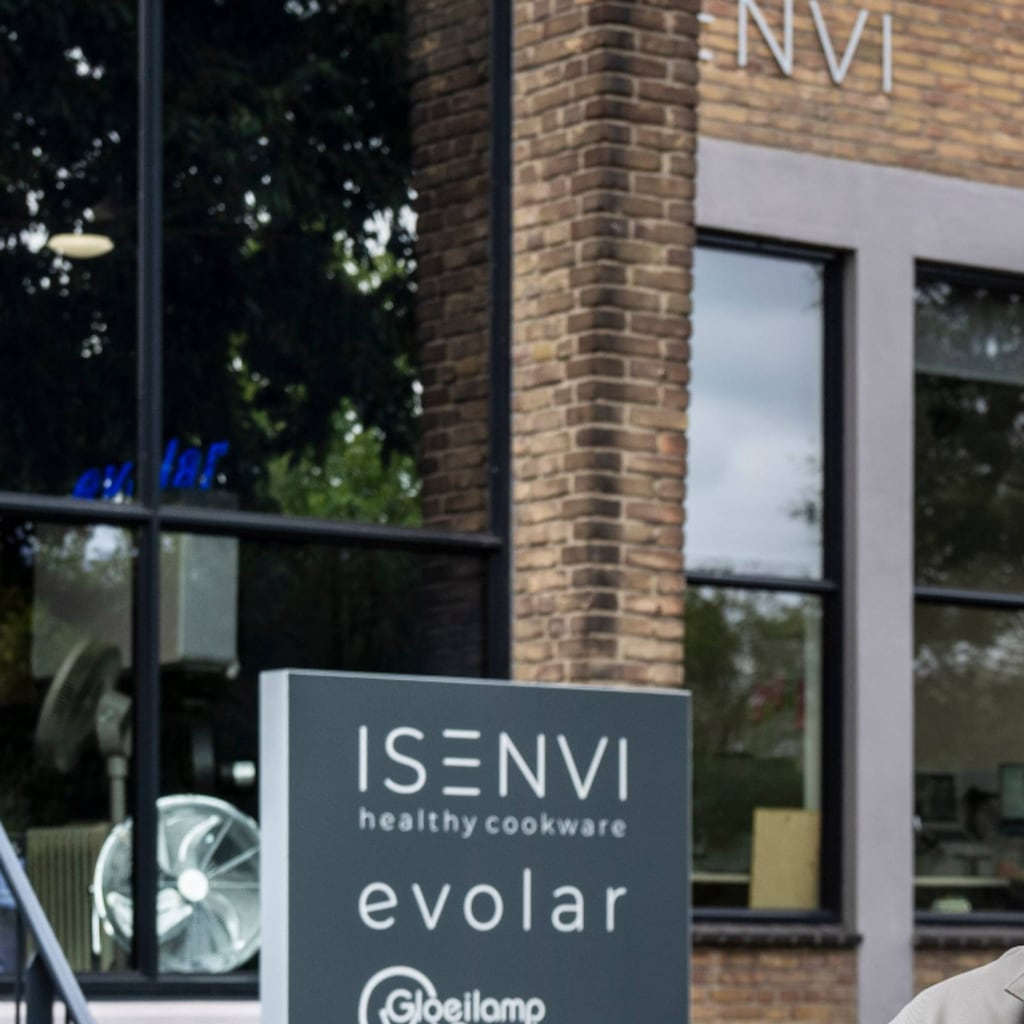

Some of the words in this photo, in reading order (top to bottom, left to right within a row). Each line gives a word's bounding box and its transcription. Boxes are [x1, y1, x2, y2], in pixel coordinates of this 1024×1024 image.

[358, 724, 628, 802] ISENVI
[359, 807, 477, 839] healthy
[485, 813, 627, 838] cookware
[358, 867, 628, 933] evolar
